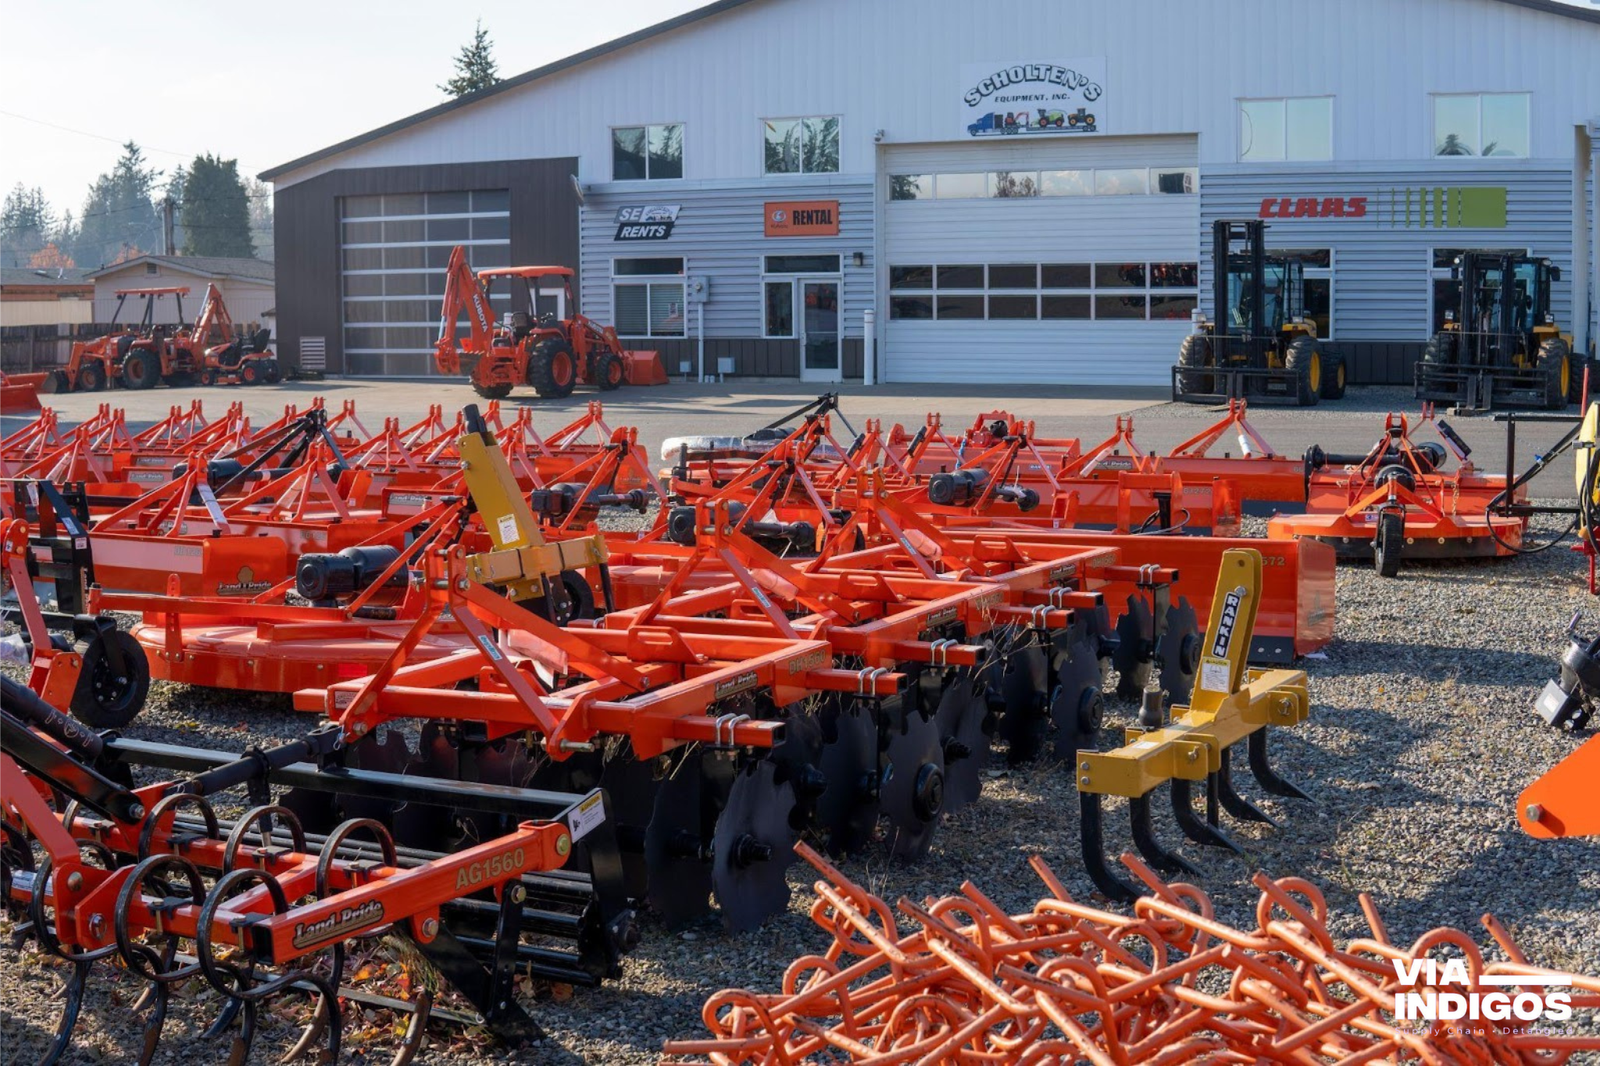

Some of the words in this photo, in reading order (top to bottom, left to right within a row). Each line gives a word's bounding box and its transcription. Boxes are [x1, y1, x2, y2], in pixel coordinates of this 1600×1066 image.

[964, 63, 1102, 107] SCHOLTEN'S
[995, 95, 1049, 103] EQUIPMENT,
[1051, 93, 1071, 101] INC.
[619, 208, 643, 221] SE
[792, 209, 833, 225] RENTAL
[1259, 197, 1368, 218] CLAAS
[620, 225, 667, 238] RENTS
[472, 293, 488, 333] KUBOTA
[1261, 556, 1285, 566] 572
[1214, 595, 1239, 658] RANKIN
[788, 649, 826, 675] DH1560
[455, 848, 525, 891] AG1560
[295, 912, 337, 937] Land
[340, 899, 383, 922] Pride
